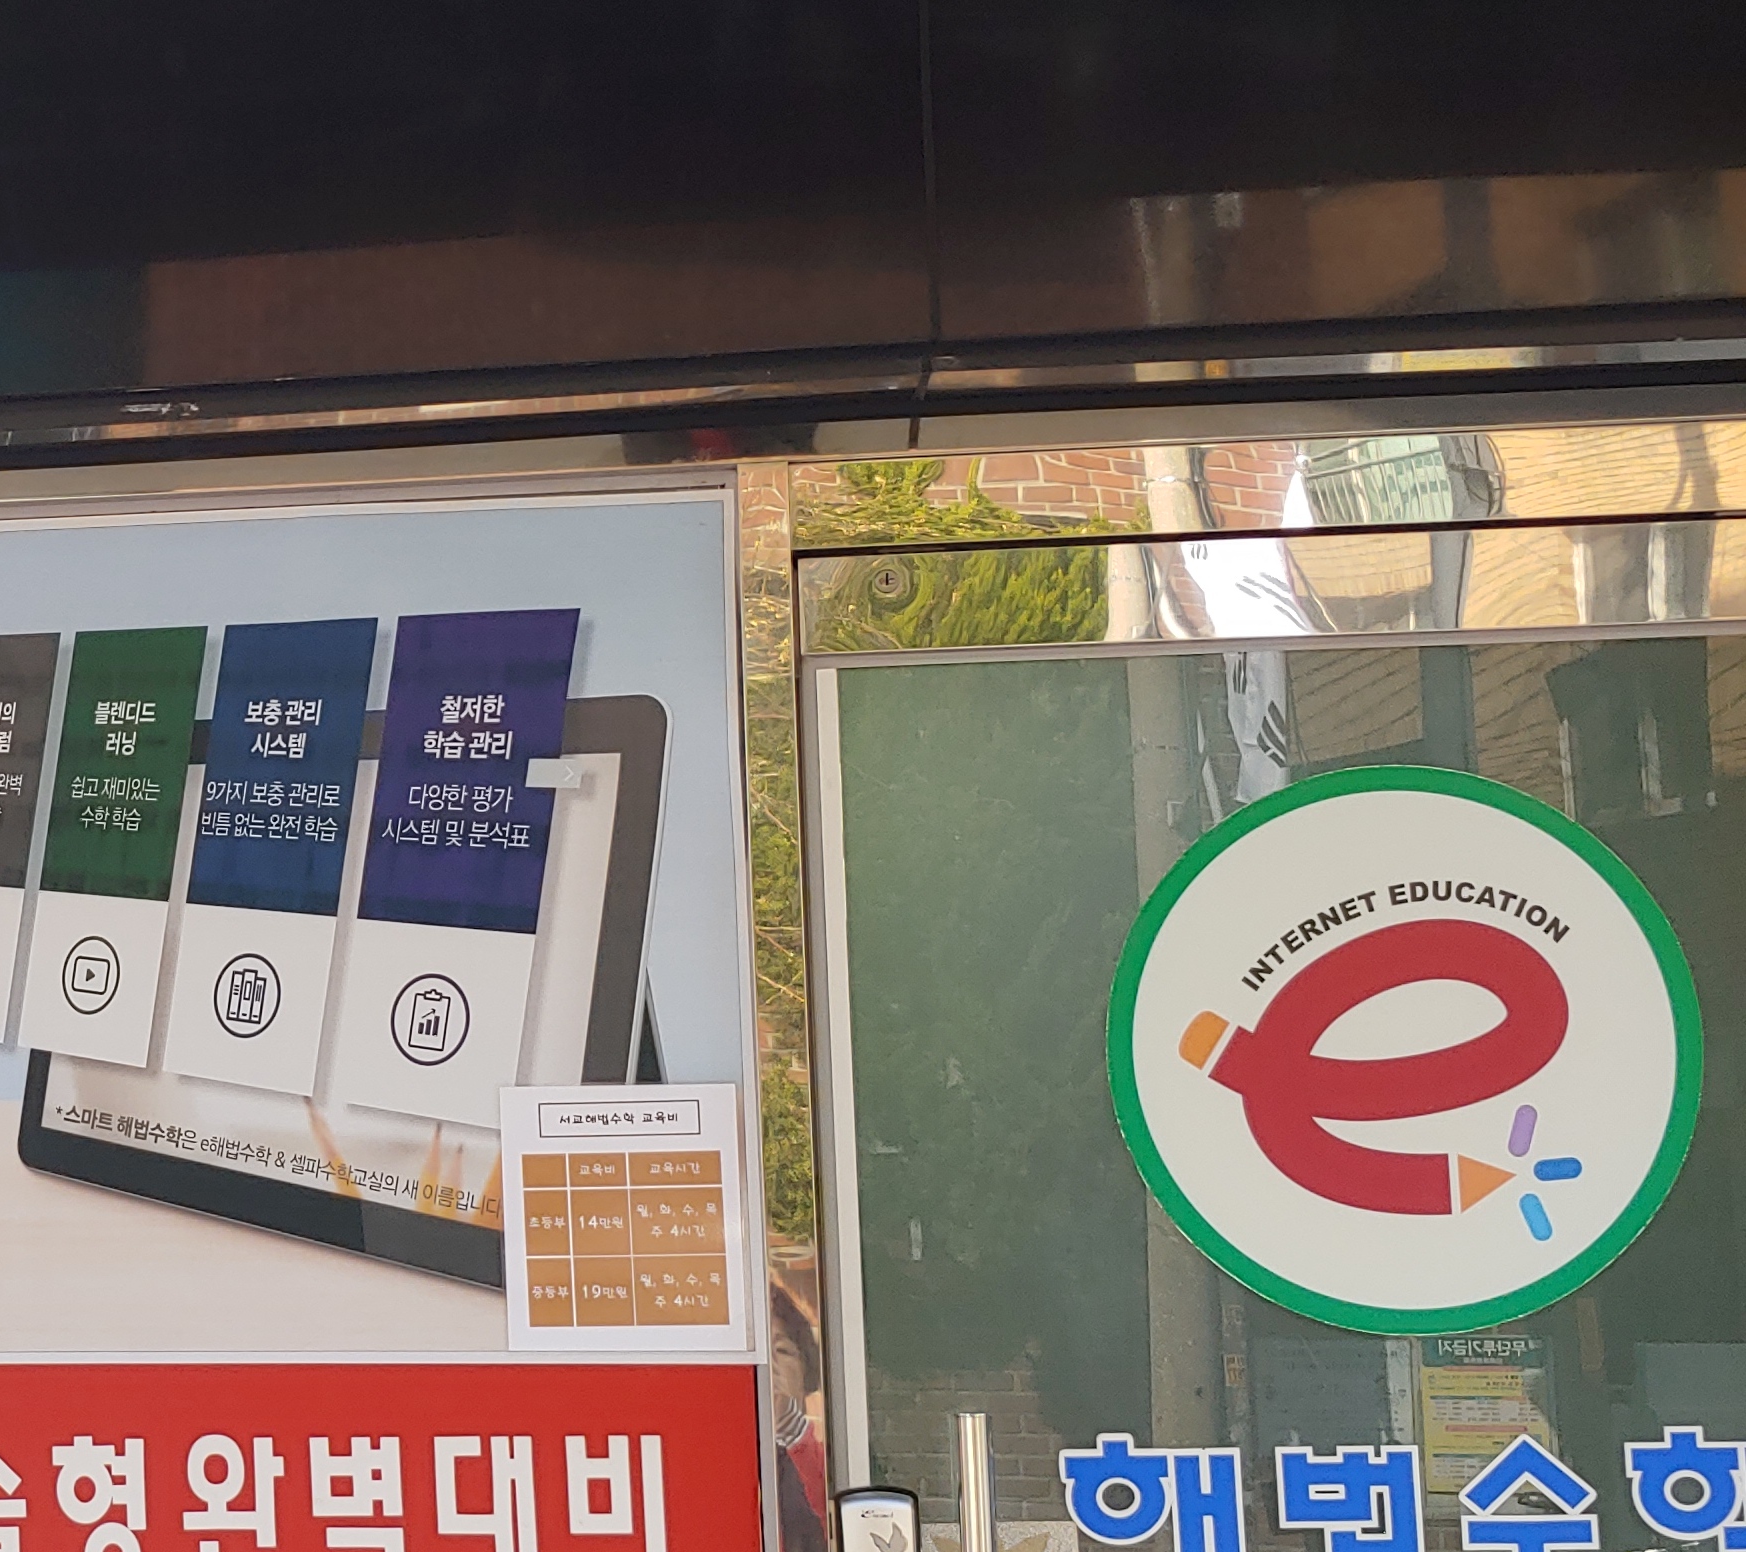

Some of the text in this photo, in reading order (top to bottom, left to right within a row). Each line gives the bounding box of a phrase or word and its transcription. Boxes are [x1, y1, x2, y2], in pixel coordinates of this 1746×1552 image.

[94, 700, 156, 725] 블렌디드
[440, 694, 505, 724] 철저한
[105, 732, 137, 756] 러닝
[251, 732, 307, 759] 시스템
[423, 730, 513, 760] 학습 관리
[70, 775, 161, 801] 쉽고 재미있는
[206, 780, 341, 808] 9가지 보충 관리로
[407, 783, 514, 814] 다양한 평가
[80, 805, 142, 831] 수학 학습
[201, 812, 339, 842] 빈틈 없는 완전 학습
[381, 818, 531, 850] 시스템 및 분석표
[1240, 880, 1572, 994] INTERNET EDUCATION
[116, 1114, 198, 1151] 해법수학은
[200, 1135, 272, 1168] e해법수학
[274, 1150, 285, 1169] &
[290, 1153, 400, 1197] 셀파수학교실의
[402, 1179, 419, 1201] 새
